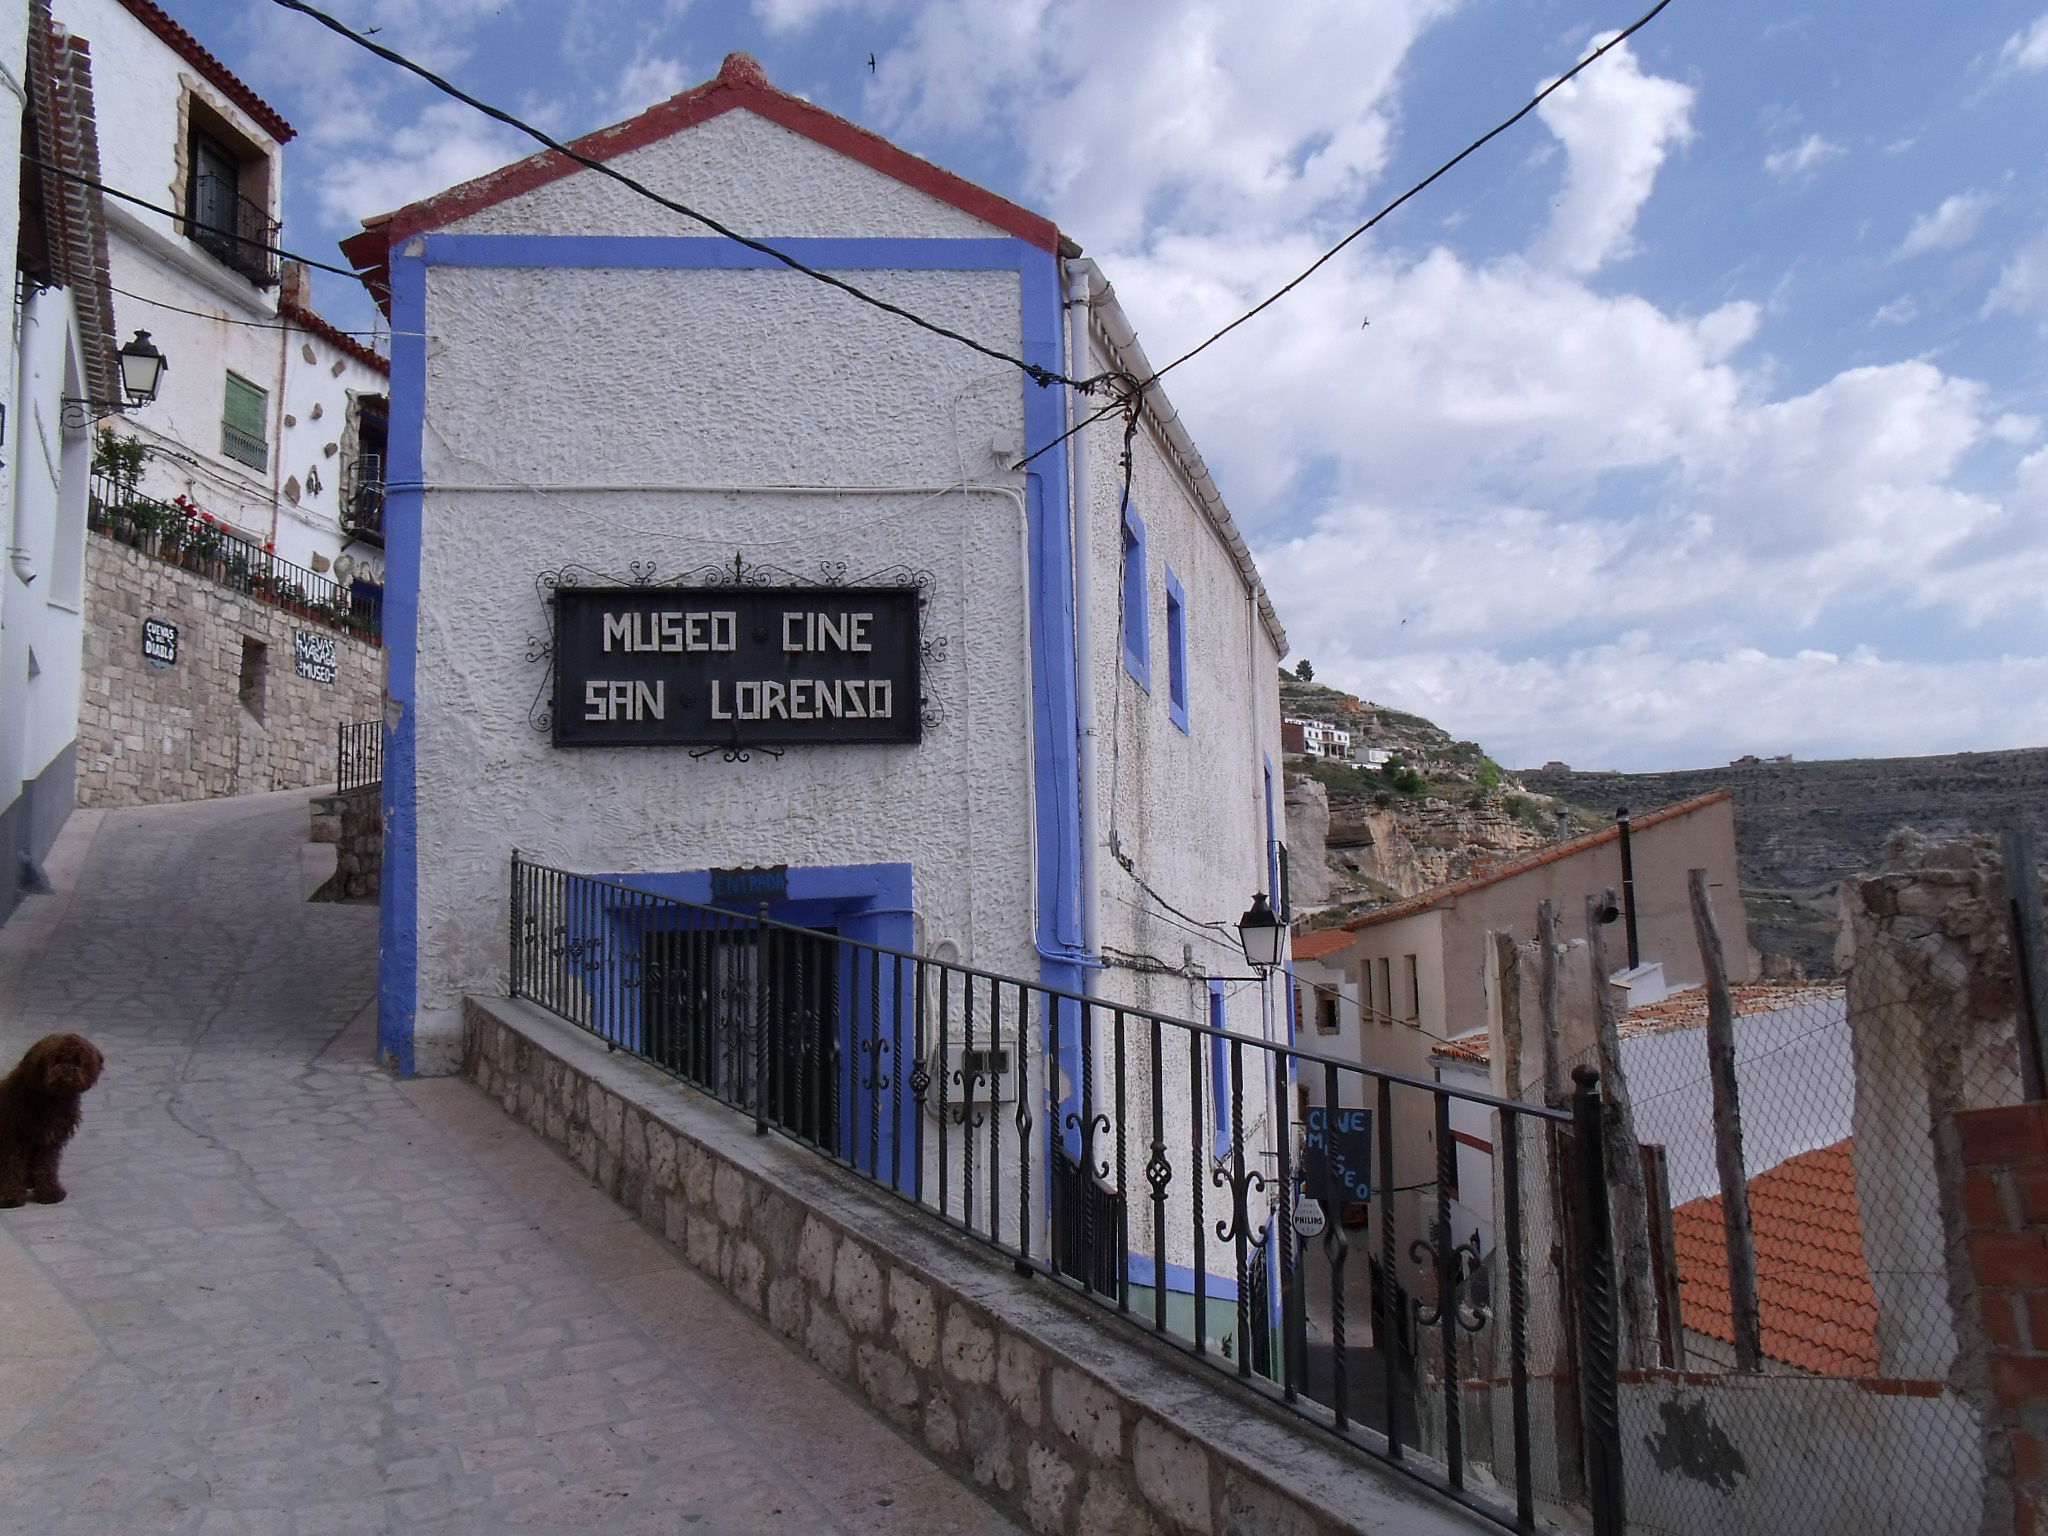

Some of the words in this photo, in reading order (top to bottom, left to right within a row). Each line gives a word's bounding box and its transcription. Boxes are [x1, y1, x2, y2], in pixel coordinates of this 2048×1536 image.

[146, 622, 174, 639] CUEVAS
[603, 611, 737, 652] MUSEO
[782, 611, 874, 652] CINE
[145, 640, 174, 660] DIABLO
[584, 680, 665, 721] SAN
